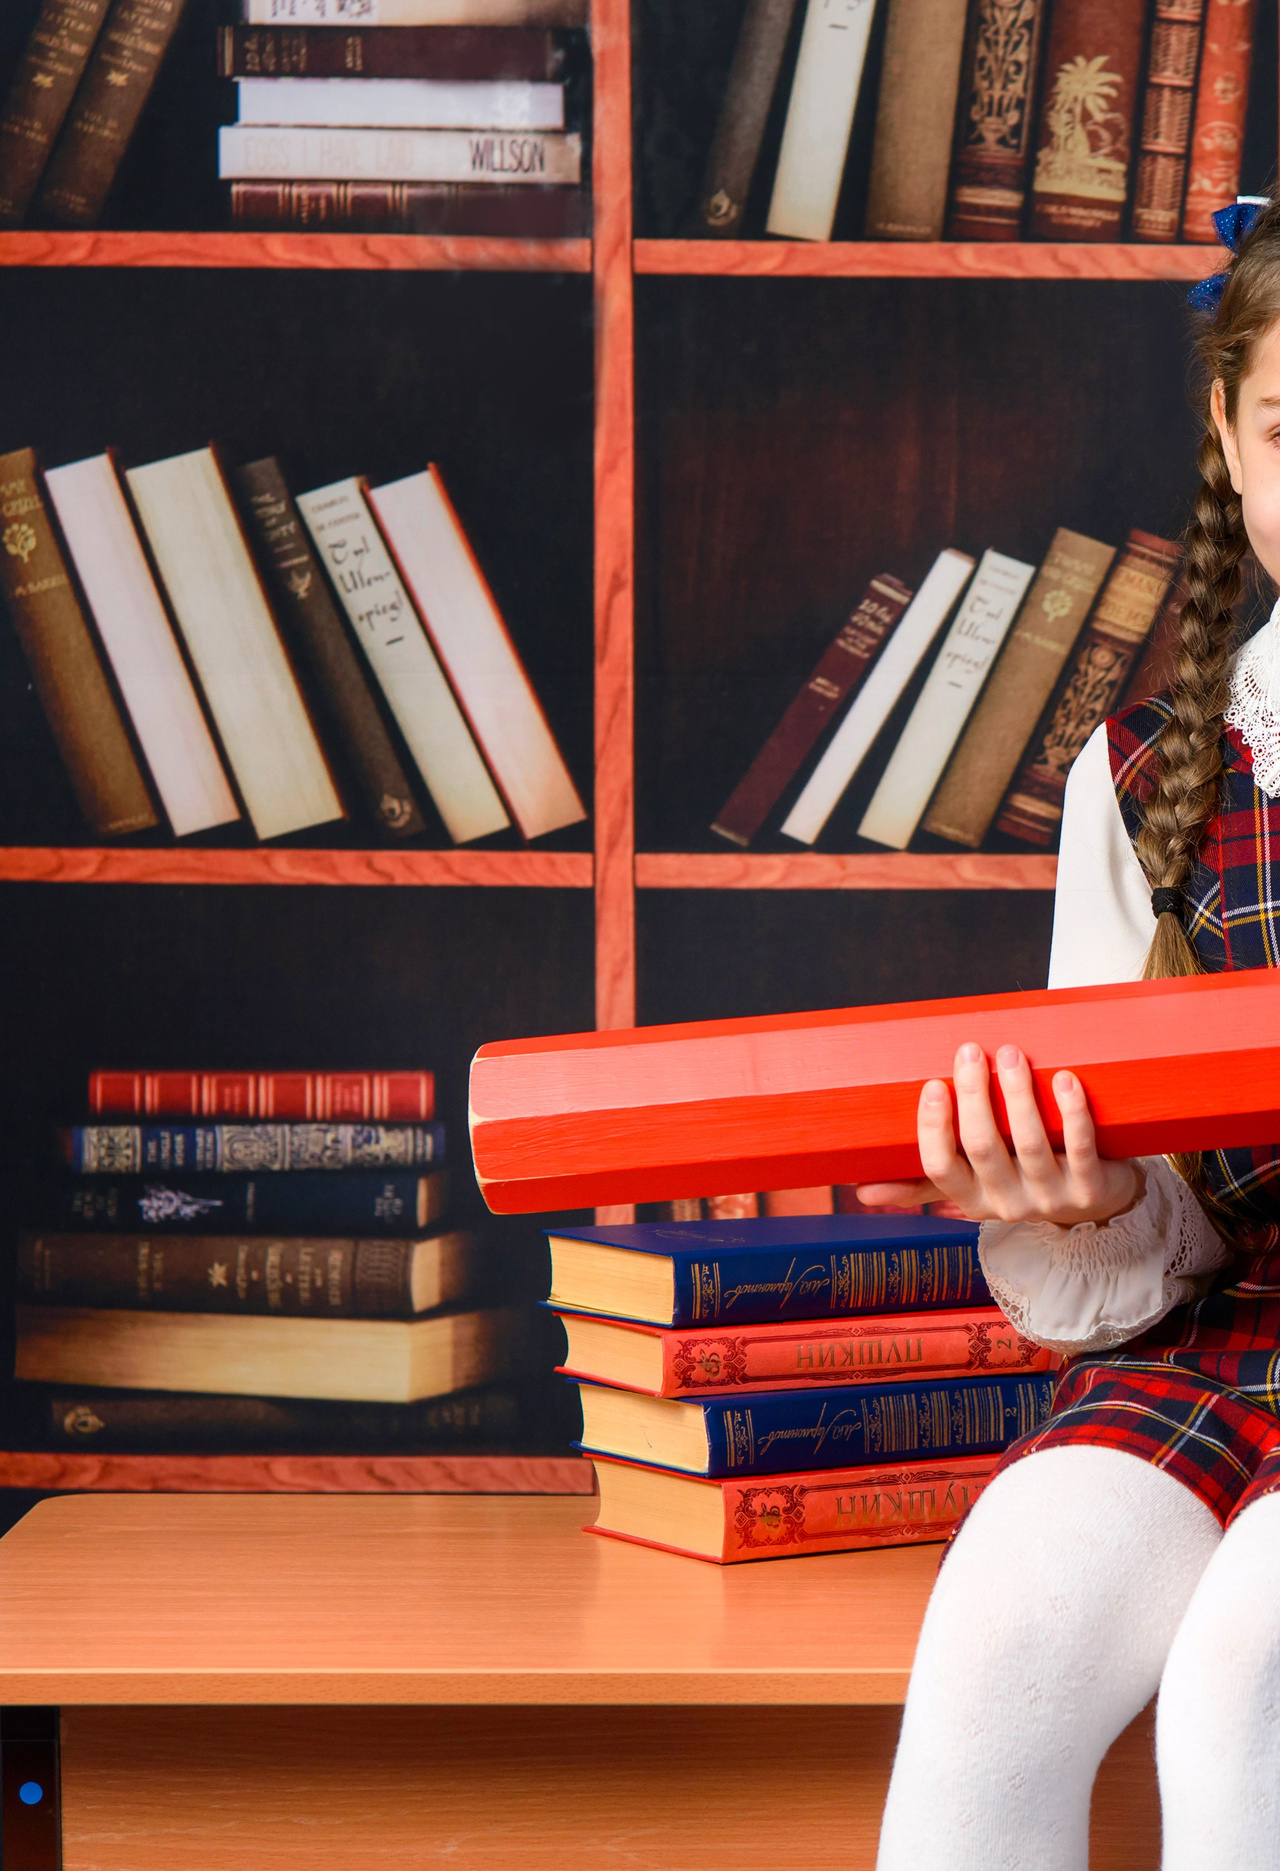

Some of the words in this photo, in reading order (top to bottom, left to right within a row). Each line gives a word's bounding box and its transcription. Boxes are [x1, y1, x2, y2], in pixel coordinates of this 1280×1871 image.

[470, 139, 545, 172] WILLSON
[795, 1334, 923, 1370] ПУШКИН
[997, 1338, 1012, 1350] 2
[1004, 1406, 1018, 1417] 2
